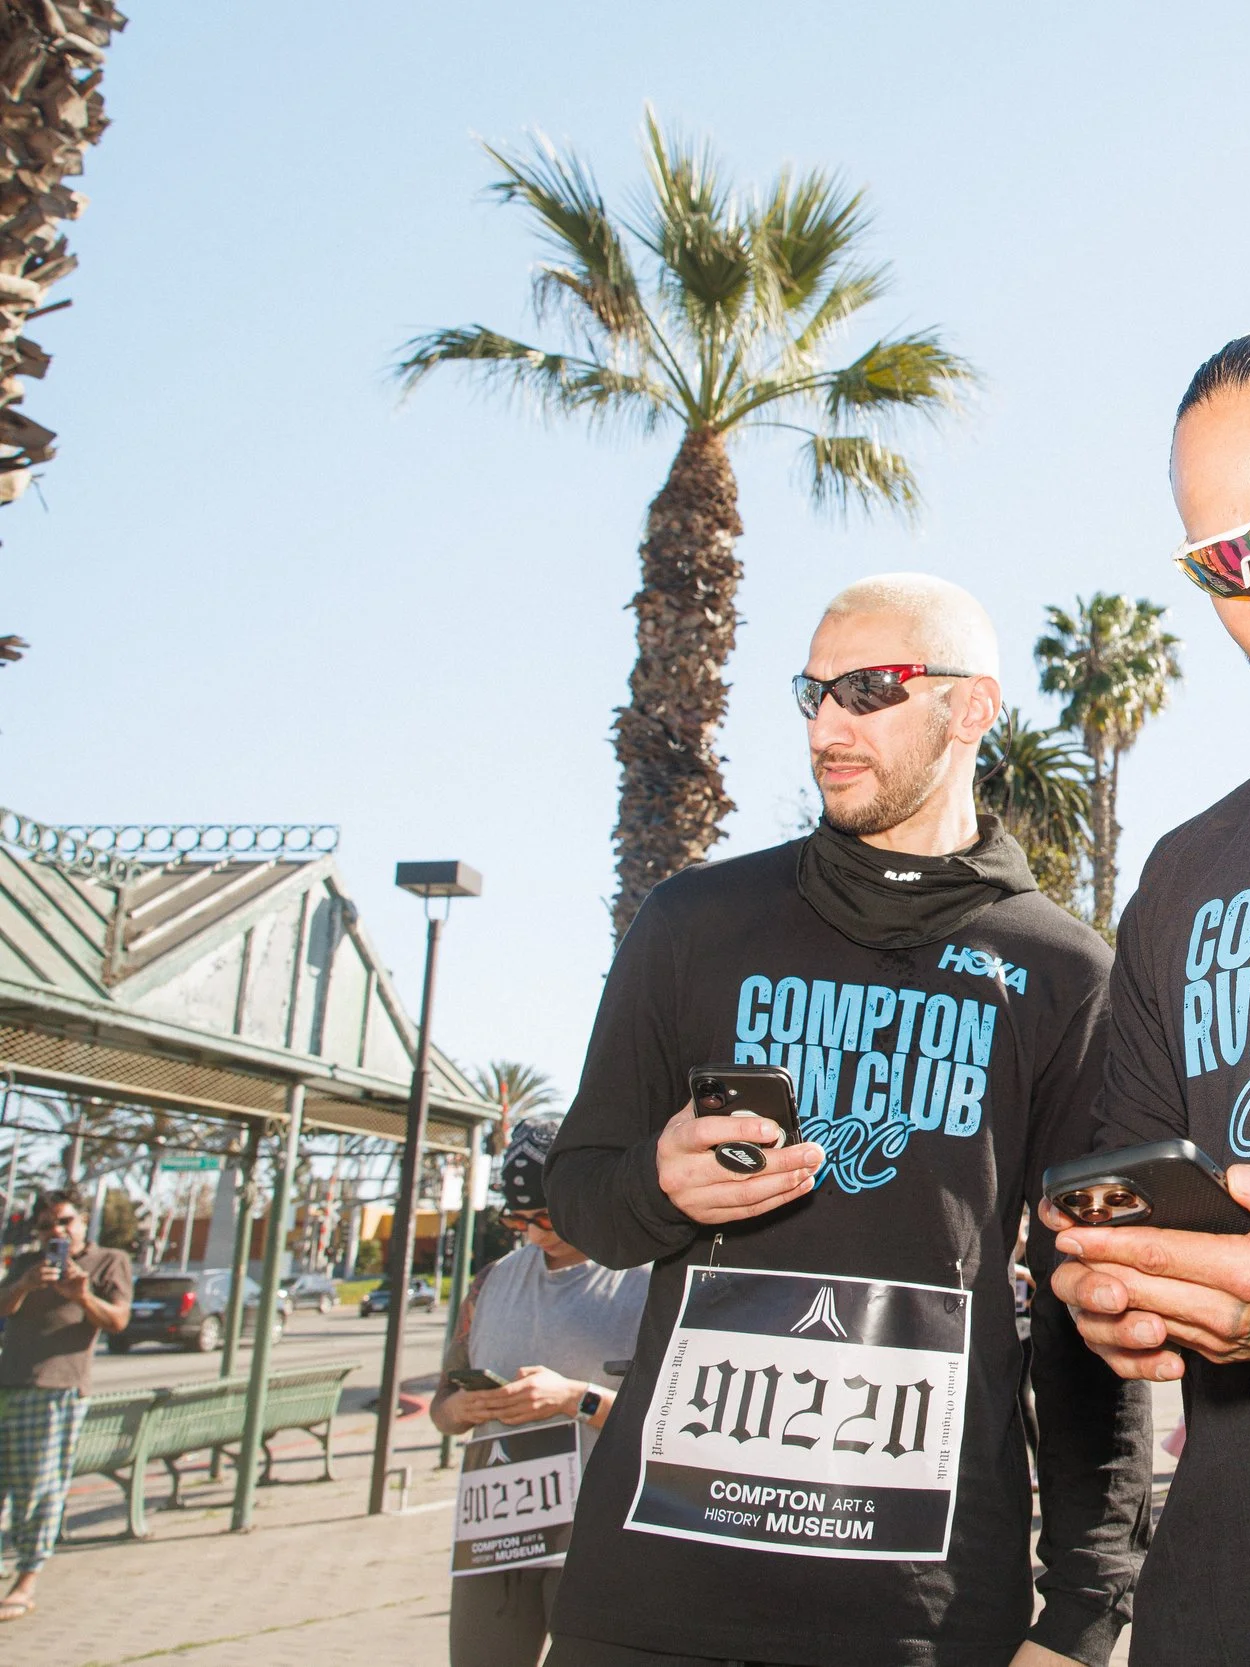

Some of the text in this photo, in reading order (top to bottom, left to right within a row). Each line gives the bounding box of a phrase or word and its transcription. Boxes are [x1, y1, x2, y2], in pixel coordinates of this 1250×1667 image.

[937, 944, 1028, 995] HOKA
[735, 975, 997, 1067] COMPTON
[851, 1051, 987, 1137] CLUB
[678, 1359, 935, 1459] 90220
[463, 1470, 562, 1525] 90220
[710, 1480, 875, 1513] COMPTON ART &
[471, 1536, 521, 1554] COMPTON
[704, 1507, 874, 1540] HISTORY MUSEUM
[495, 1543, 546, 1562] MUSEUM
